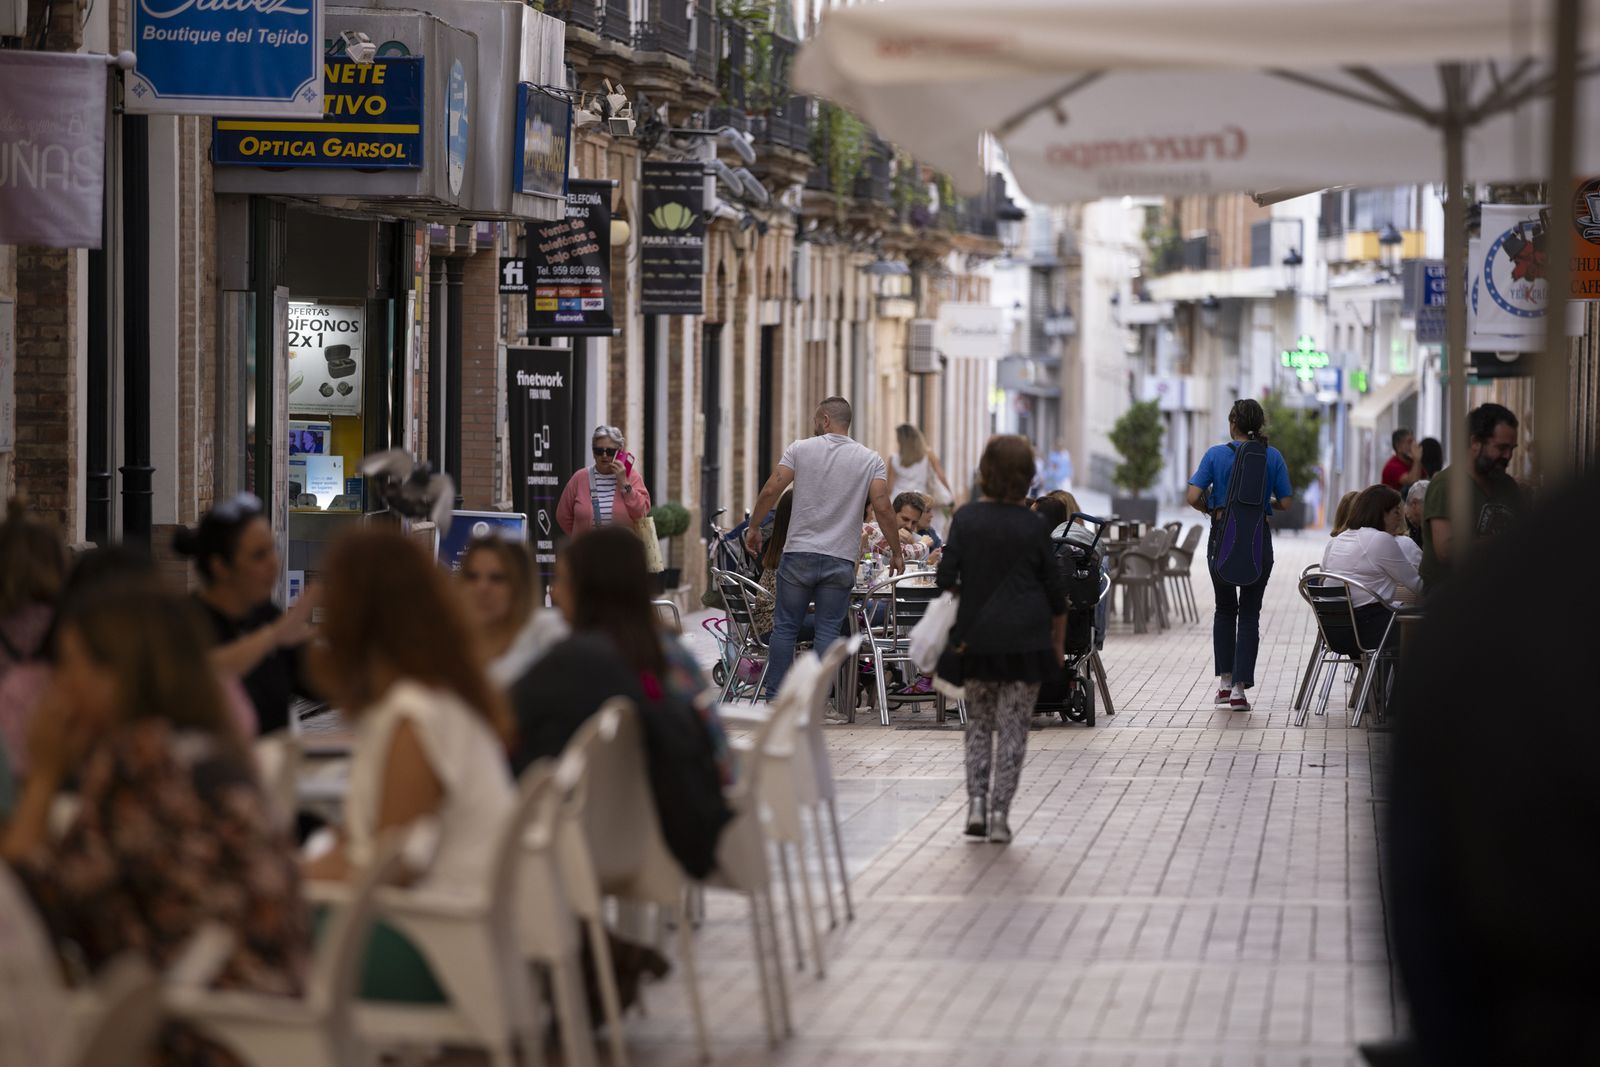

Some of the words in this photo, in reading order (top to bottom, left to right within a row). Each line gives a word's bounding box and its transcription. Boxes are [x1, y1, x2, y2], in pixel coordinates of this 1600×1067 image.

[142, 25, 221, 44] Boutique
[225, 28, 252, 43] del
[257, 29, 309, 47] Tejido
[324, 63, 387, 85] NETE
[323, 95, 387, 116] TIVO
[239, 136, 316, 157] OPTICA
[322, 137, 406, 159] GARSOL
[565, 207, 590, 218] ÓMICAS
[503, 261, 524, 285] fi
[536, 266, 551, 275] Tel.
[552, 266, 568, 275] 959
[585, 266, 601, 275] 658
[288, 316, 360, 333] DÍFONOS
[516, 370, 563, 387] finetwork
